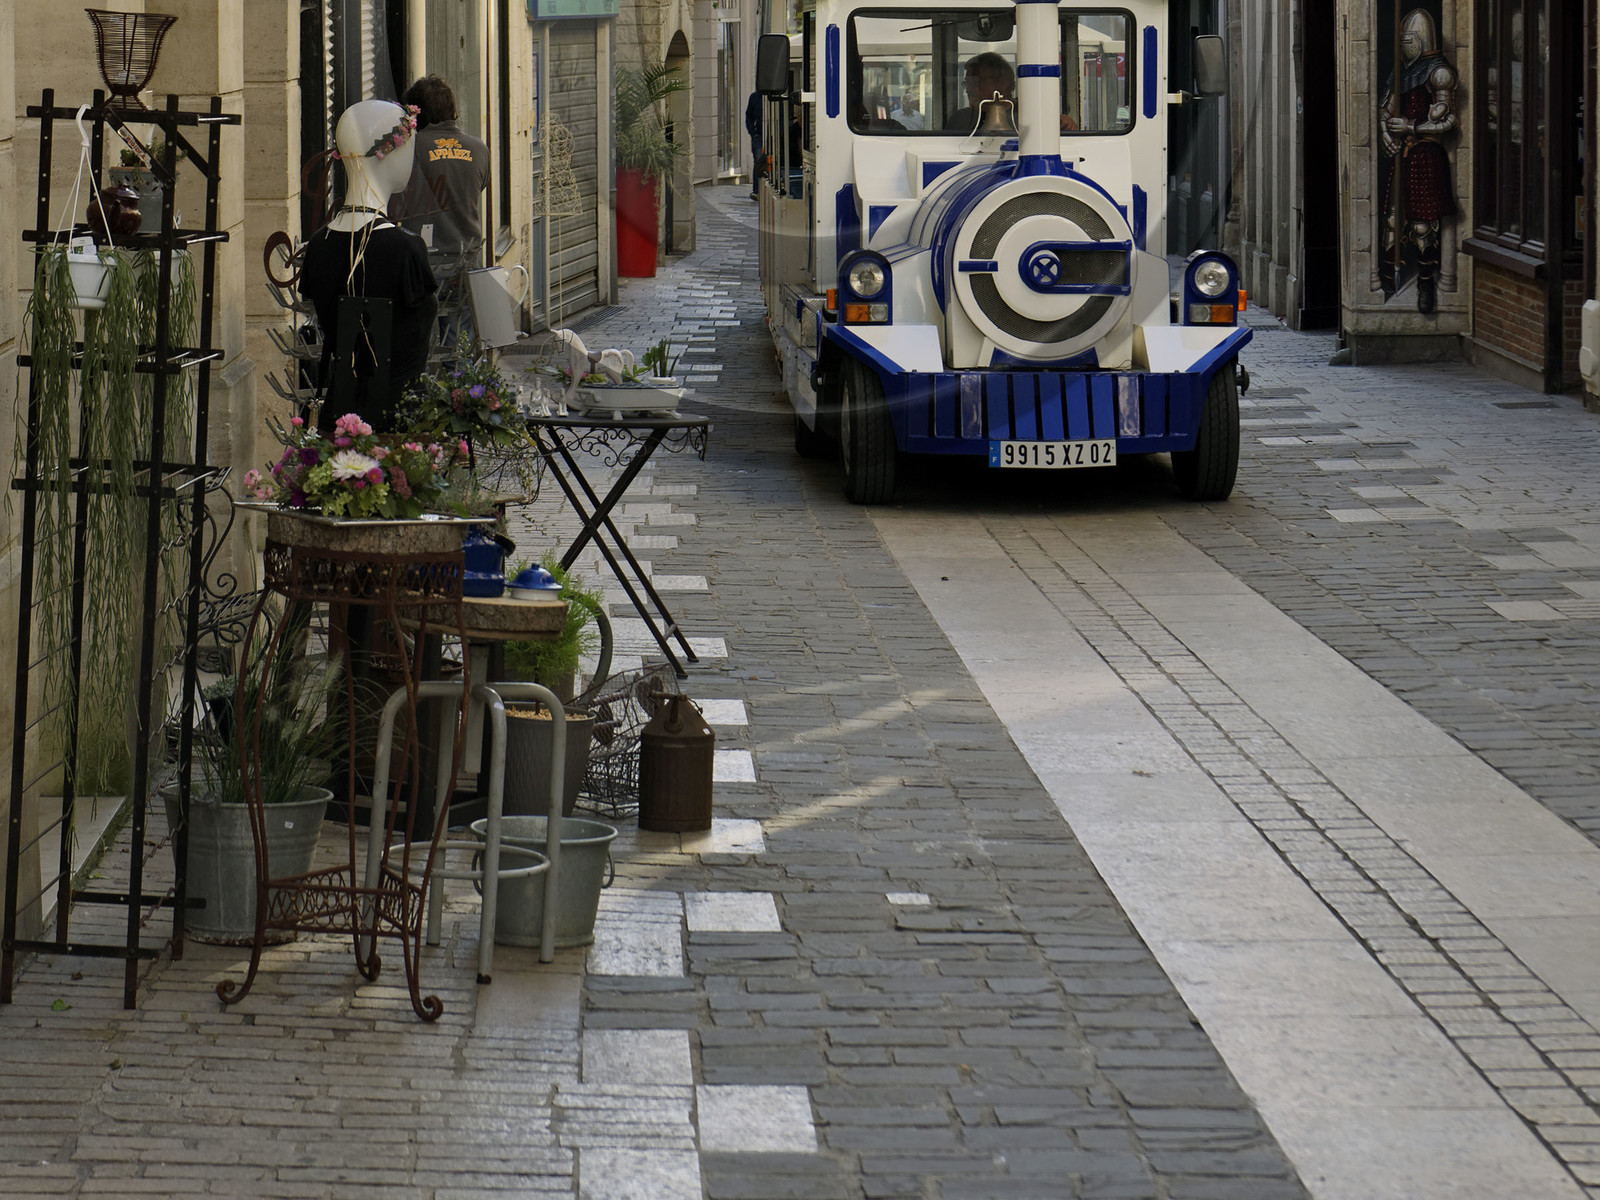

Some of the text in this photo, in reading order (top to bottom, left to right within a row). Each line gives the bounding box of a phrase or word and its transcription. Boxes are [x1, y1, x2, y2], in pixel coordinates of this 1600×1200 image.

[429, 148, 472, 162] APPAREL
[1005, 443, 1111, 465] 9915 XZ 02
